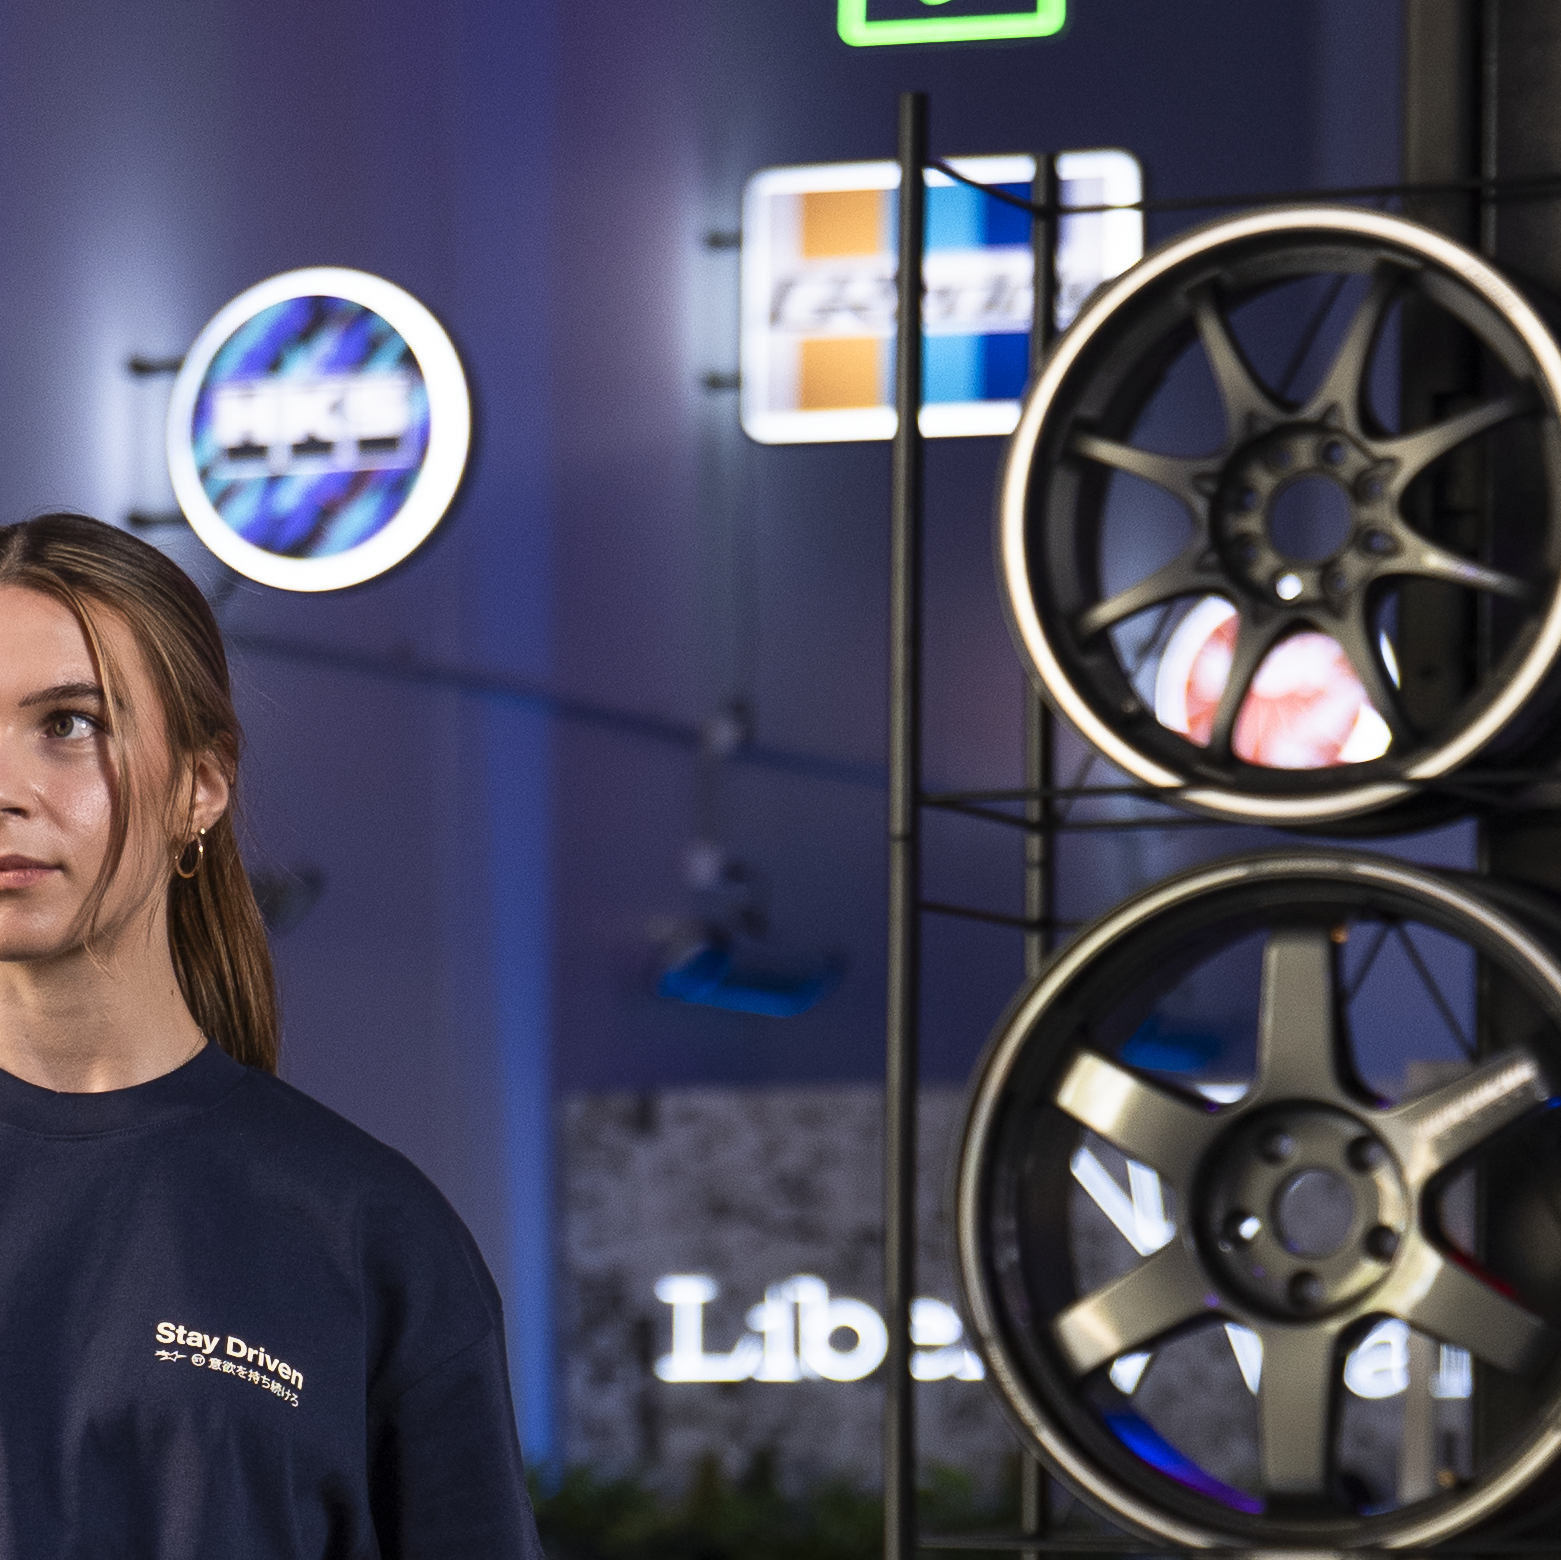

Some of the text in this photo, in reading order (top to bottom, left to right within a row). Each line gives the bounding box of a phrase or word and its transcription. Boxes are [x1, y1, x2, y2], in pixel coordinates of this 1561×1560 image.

[156, 1322, 304, 1390] Stay Driven
[653, 1273, 984, 1382] Libe
